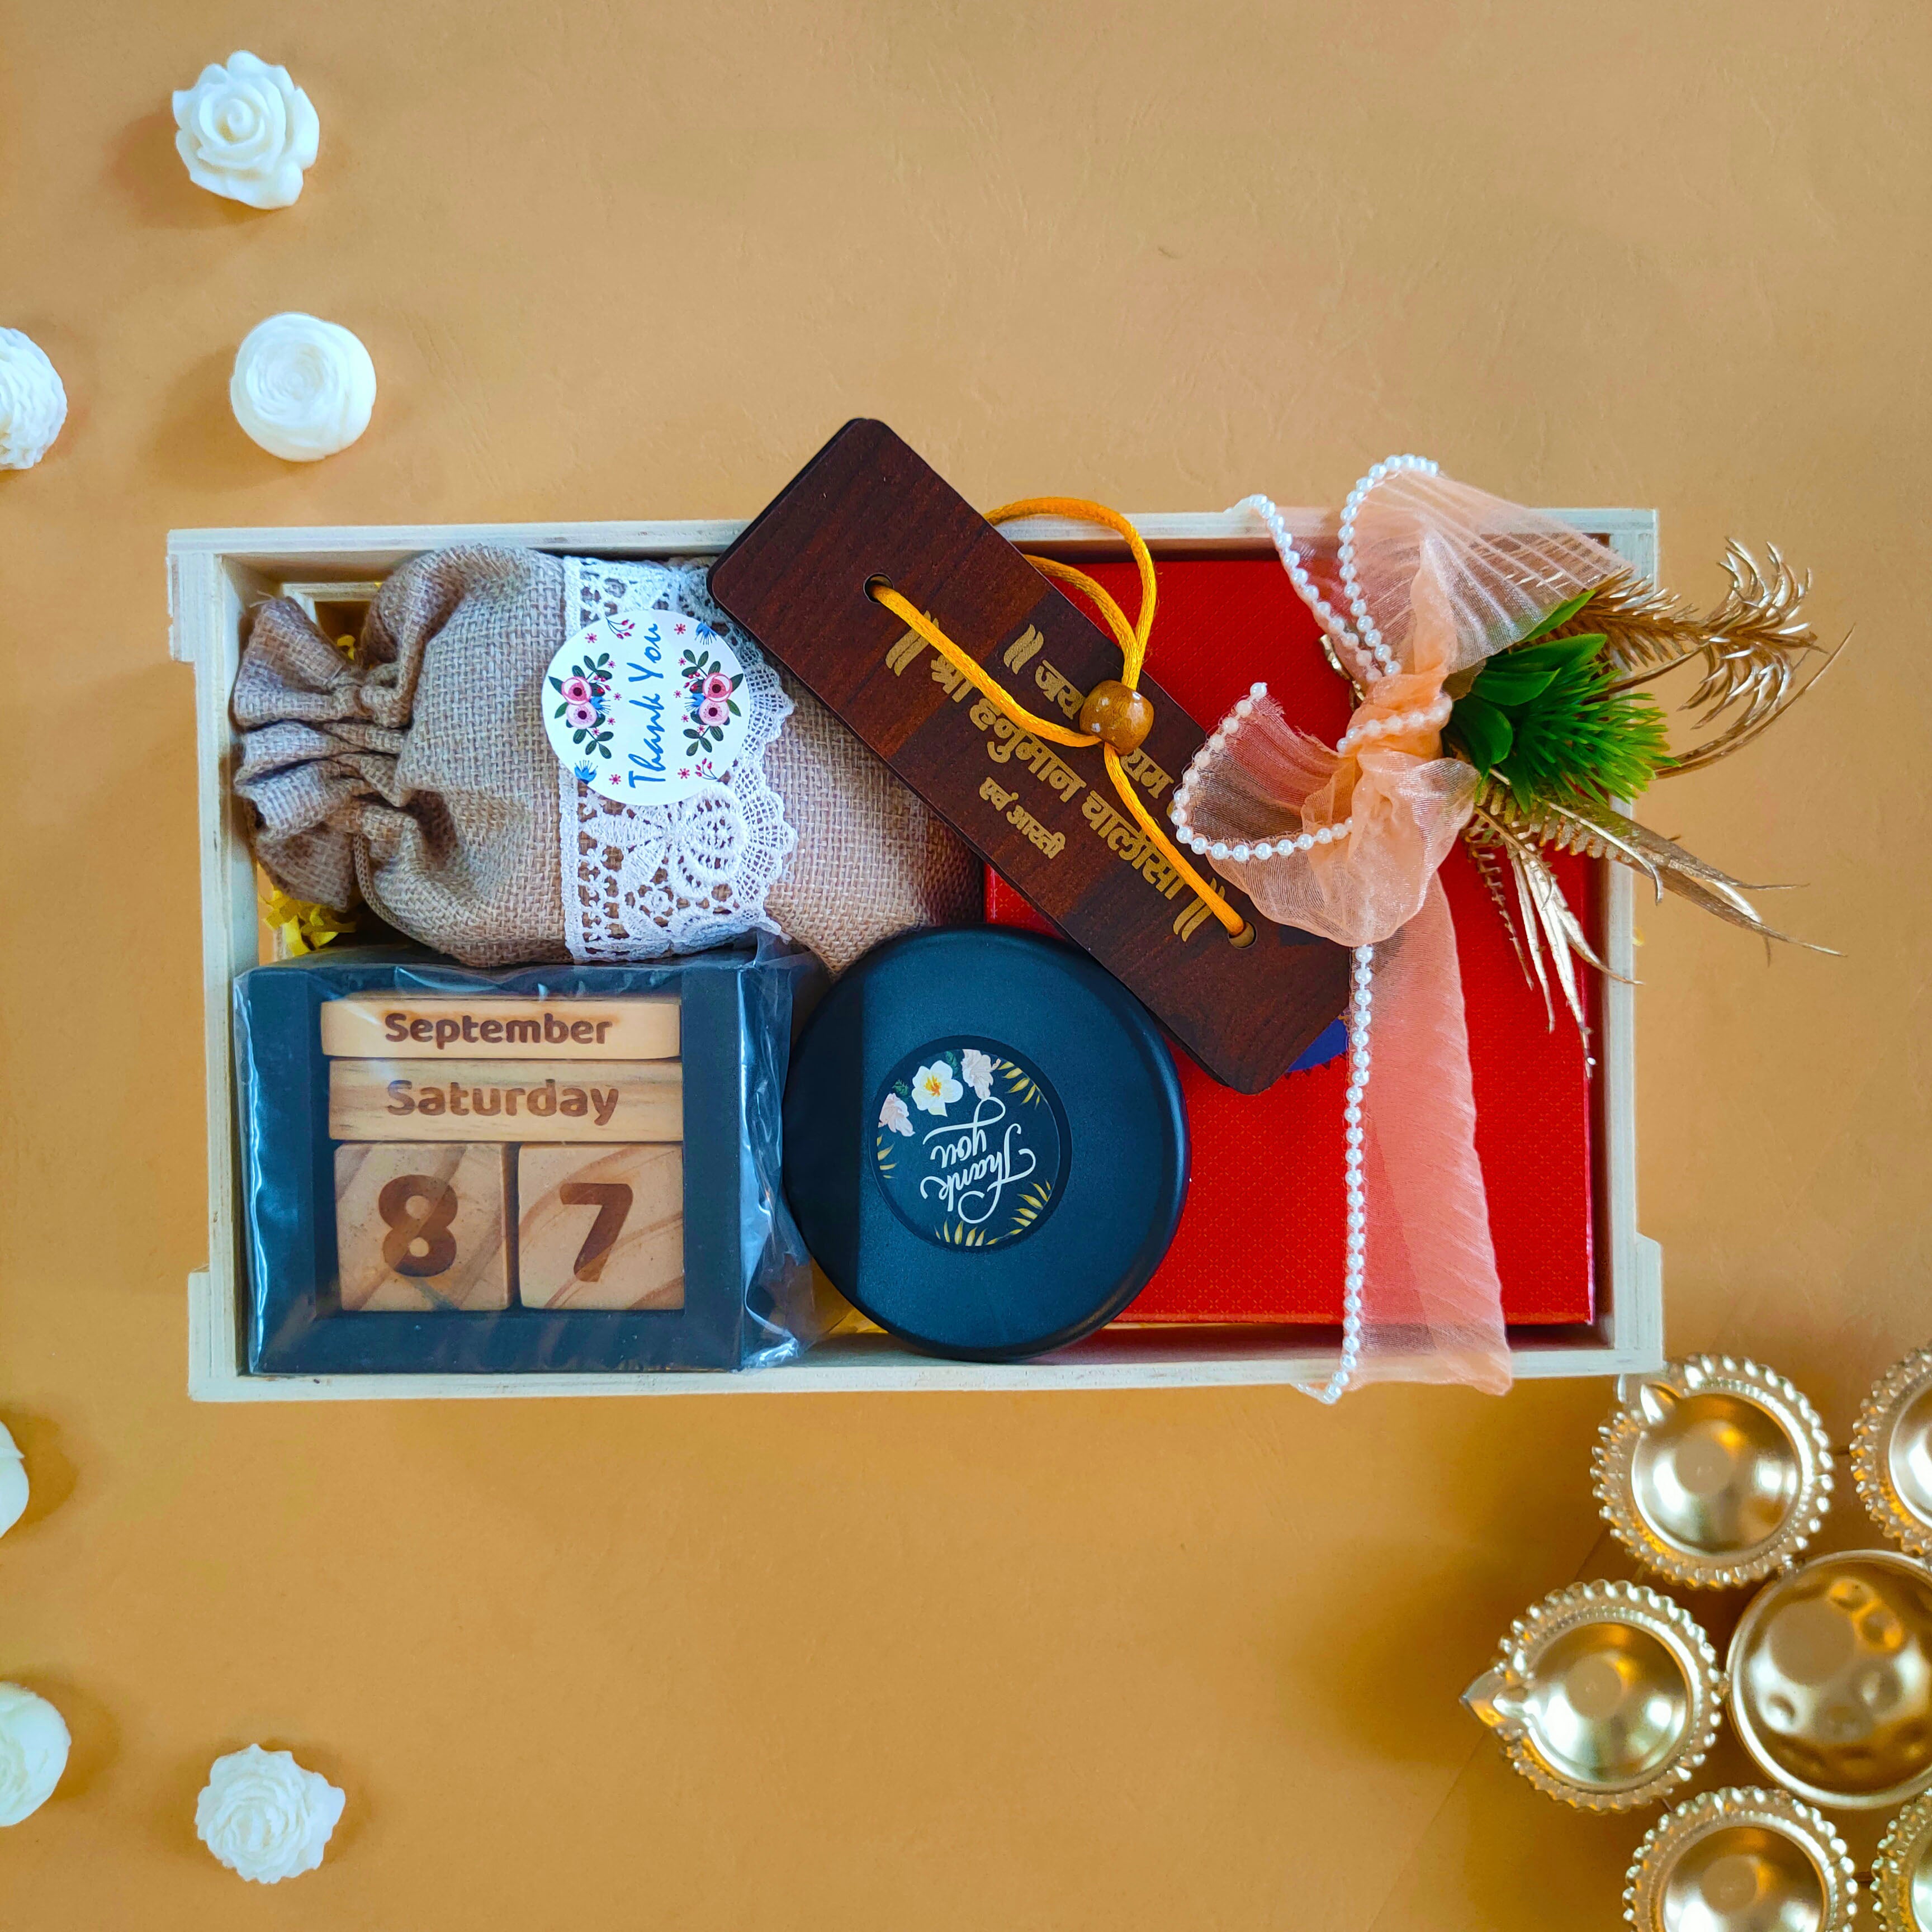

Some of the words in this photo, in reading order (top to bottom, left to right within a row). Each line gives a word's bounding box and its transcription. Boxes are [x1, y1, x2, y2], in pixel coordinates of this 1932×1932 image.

[627, 623, 664, 683] You
[628, 693, 666, 789] Thank
[1035, 660, 1087, 719] जय
[1117, 748, 1175, 799] राम
[969, 698, 1087, 803] हनुमान
[1081, 790, 1190, 901] चालीसा
[979, 776, 1019, 811] एवं
[1006, 804, 1066, 859] आरती
[385, 1012, 613, 1050] September
[387, 1079, 619, 1126] Saturday
[922, 1096, 1006, 1169] you
[920, 1123, 1036, 1224] Thank
[378, 1174, 458, 1278] 8
[560, 1182, 633, 1282] 7
